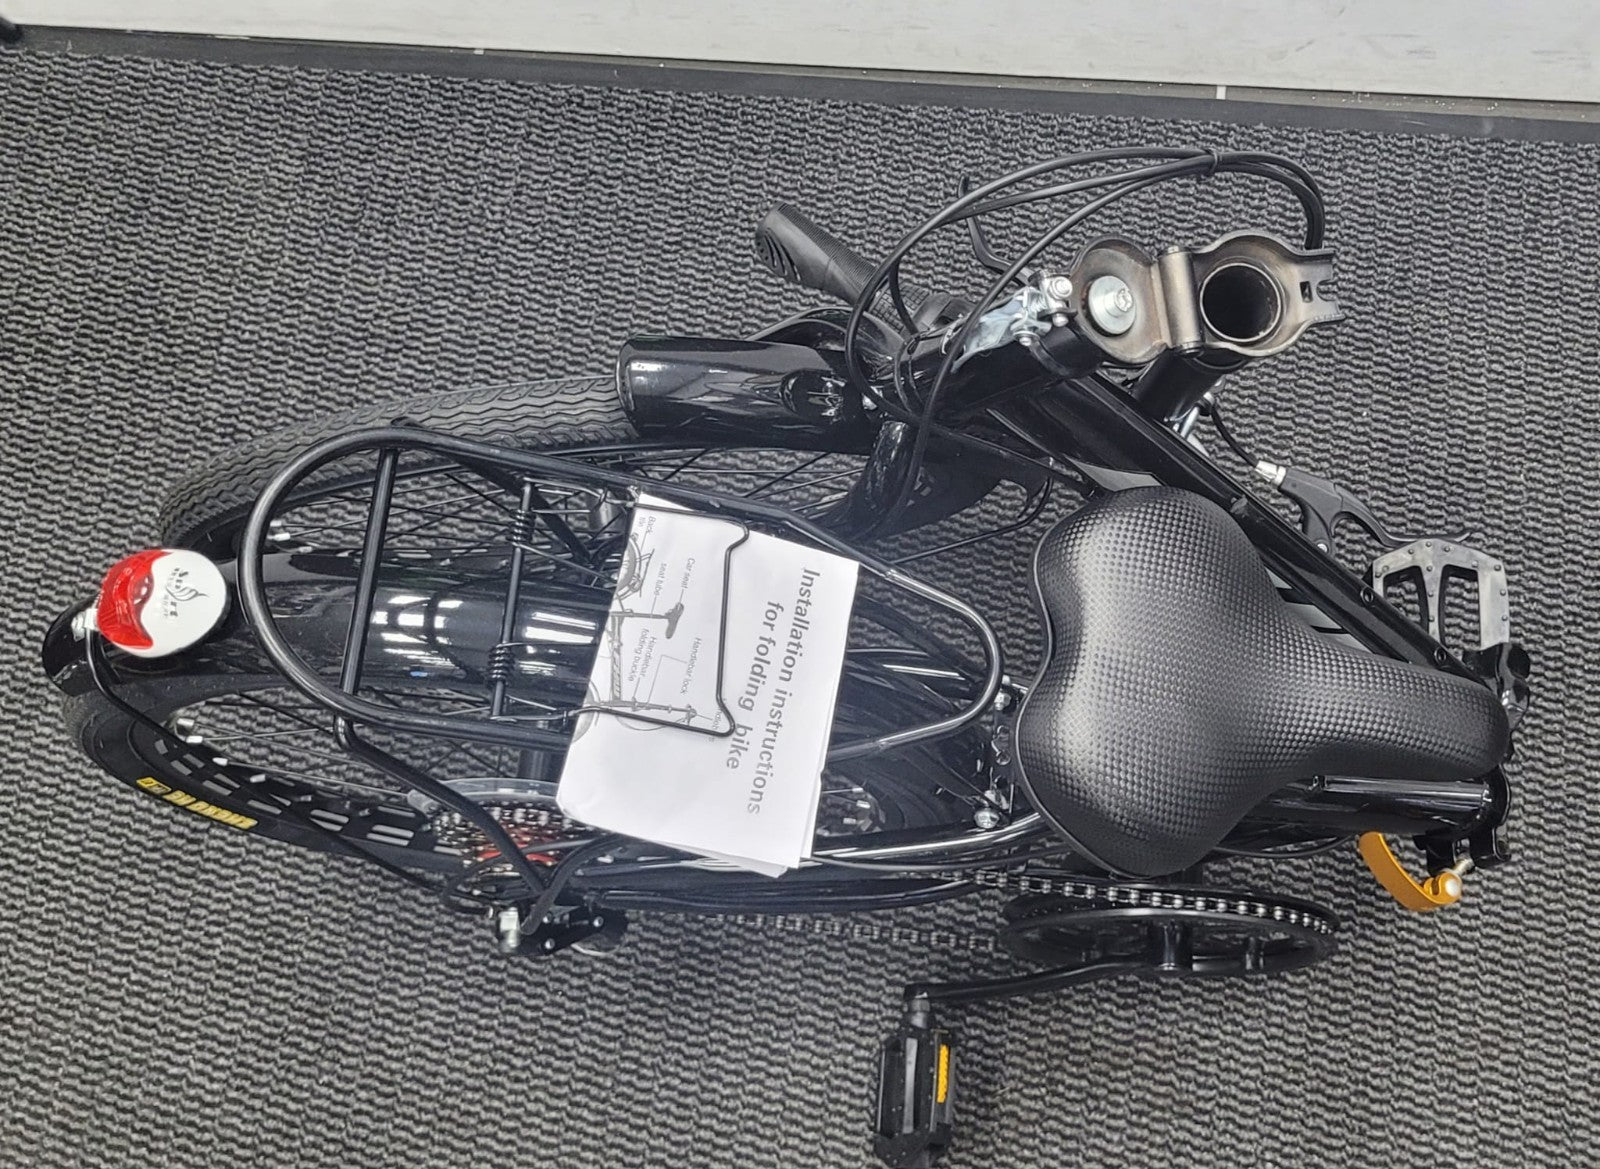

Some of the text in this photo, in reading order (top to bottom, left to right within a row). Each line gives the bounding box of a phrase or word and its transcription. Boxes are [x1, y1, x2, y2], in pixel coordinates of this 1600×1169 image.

[654, 563, 668, 596] seat tube
[681, 557, 696, 589] Car seat
[627, 628, 650, 682] folding buckle
[640, 636, 657, 678] Handlebar
[680, 637, 702, 695] Handlebar lock
[726, 601, 785, 770] for folding bike
[747, 568, 821, 815] Installation instructions
